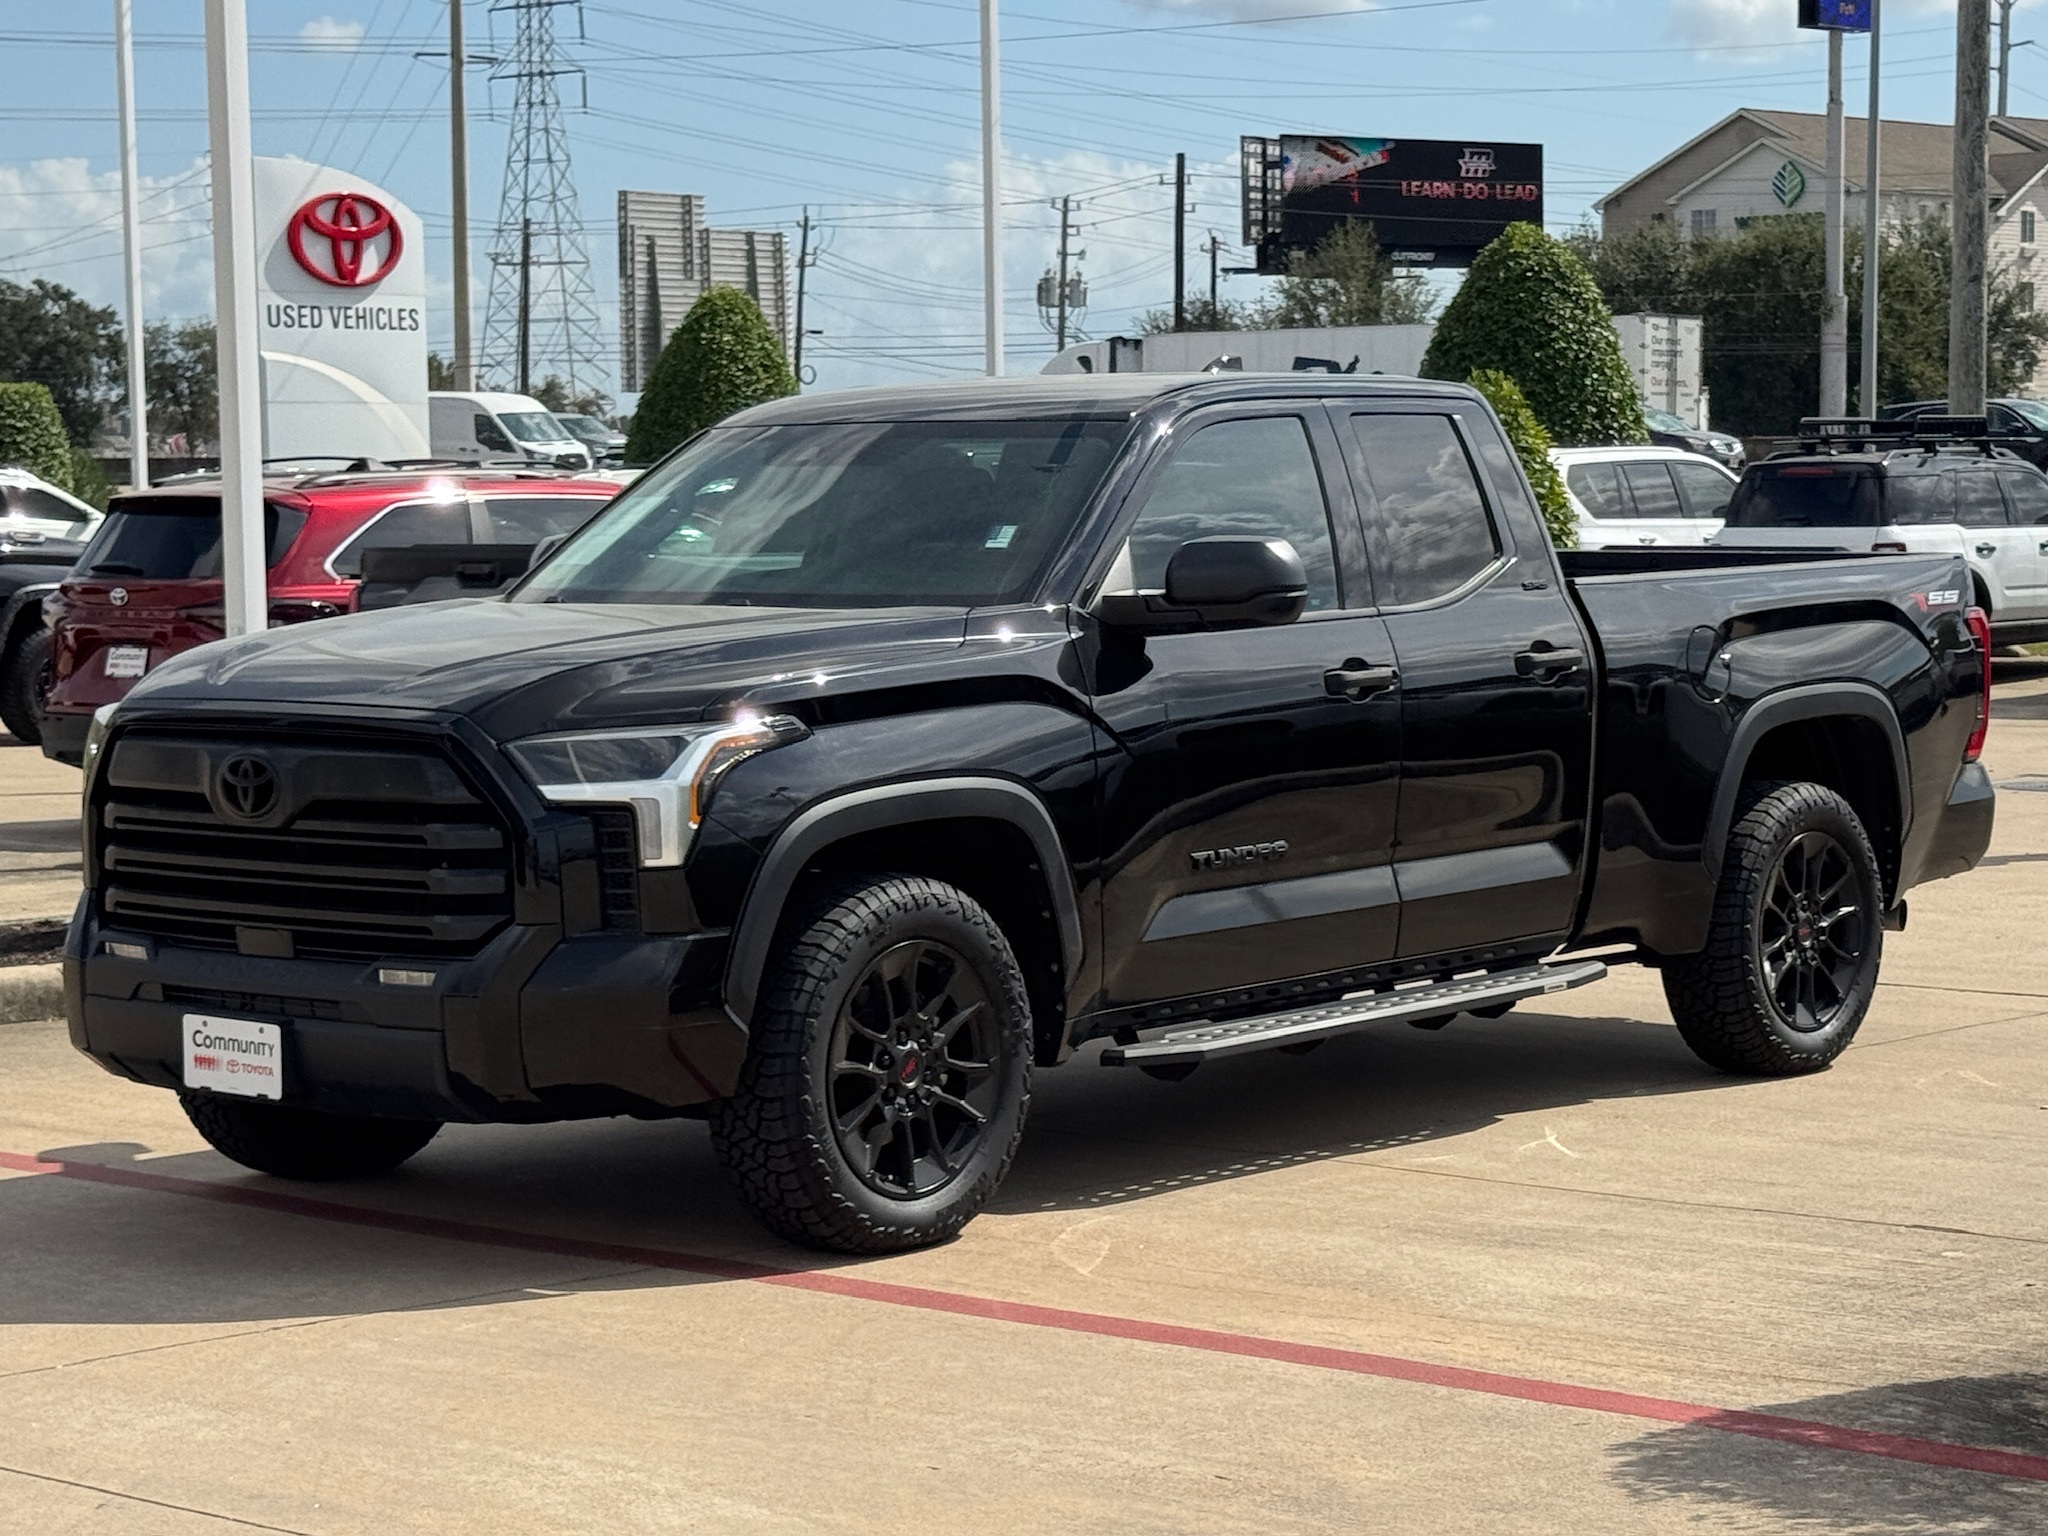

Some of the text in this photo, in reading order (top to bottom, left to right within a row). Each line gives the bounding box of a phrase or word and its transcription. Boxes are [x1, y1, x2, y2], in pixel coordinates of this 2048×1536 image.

[1401, 180, 1539, 202] LEARN DO LEAD
[267, 304, 420, 331] USED VEHICLES
[1190, 840, 1290, 869] TUNDRA
[241, 1063, 275, 1077] TOYOTA
